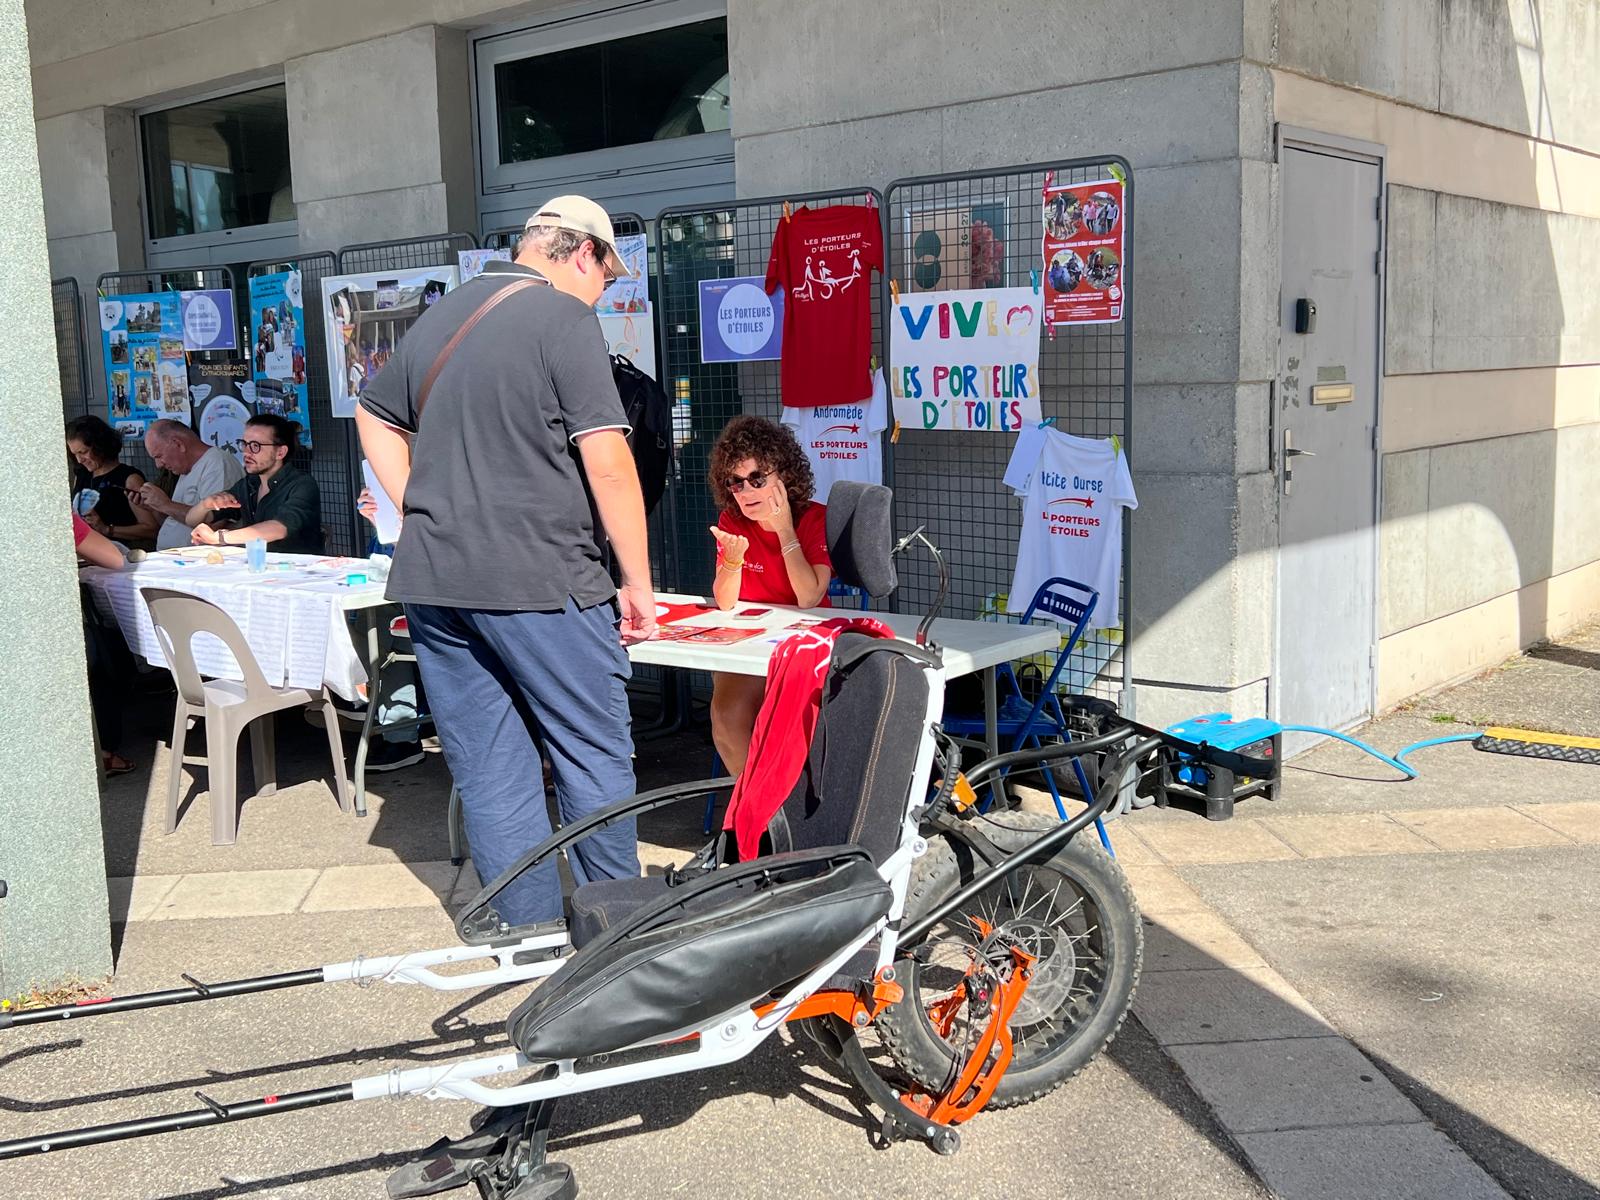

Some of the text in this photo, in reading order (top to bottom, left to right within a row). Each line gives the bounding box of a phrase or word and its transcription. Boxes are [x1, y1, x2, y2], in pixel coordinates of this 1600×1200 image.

[804, 232, 862, 246] LES PORTEURS
[811, 242, 851, 253] D'ÉTOILES
[720, 305, 771, 320] LES PORTEURS
[899, 300, 998, 340] VIVE
[727, 321, 764, 334] D'ÉTOILES
[892, 363, 1038, 399] LES PORTEURS
[813, 405, 863, 420] Andromède
[810, 441, 868, 449] LES PORTEURS
[820, 451, 858, 460] D'ÉTOILES
[1073, 476, 1103, 493] Ourse
[1050, 513, 1101, 527] PORTEURS
[1048, 524, 1090, 538] 'ÉTOILES
